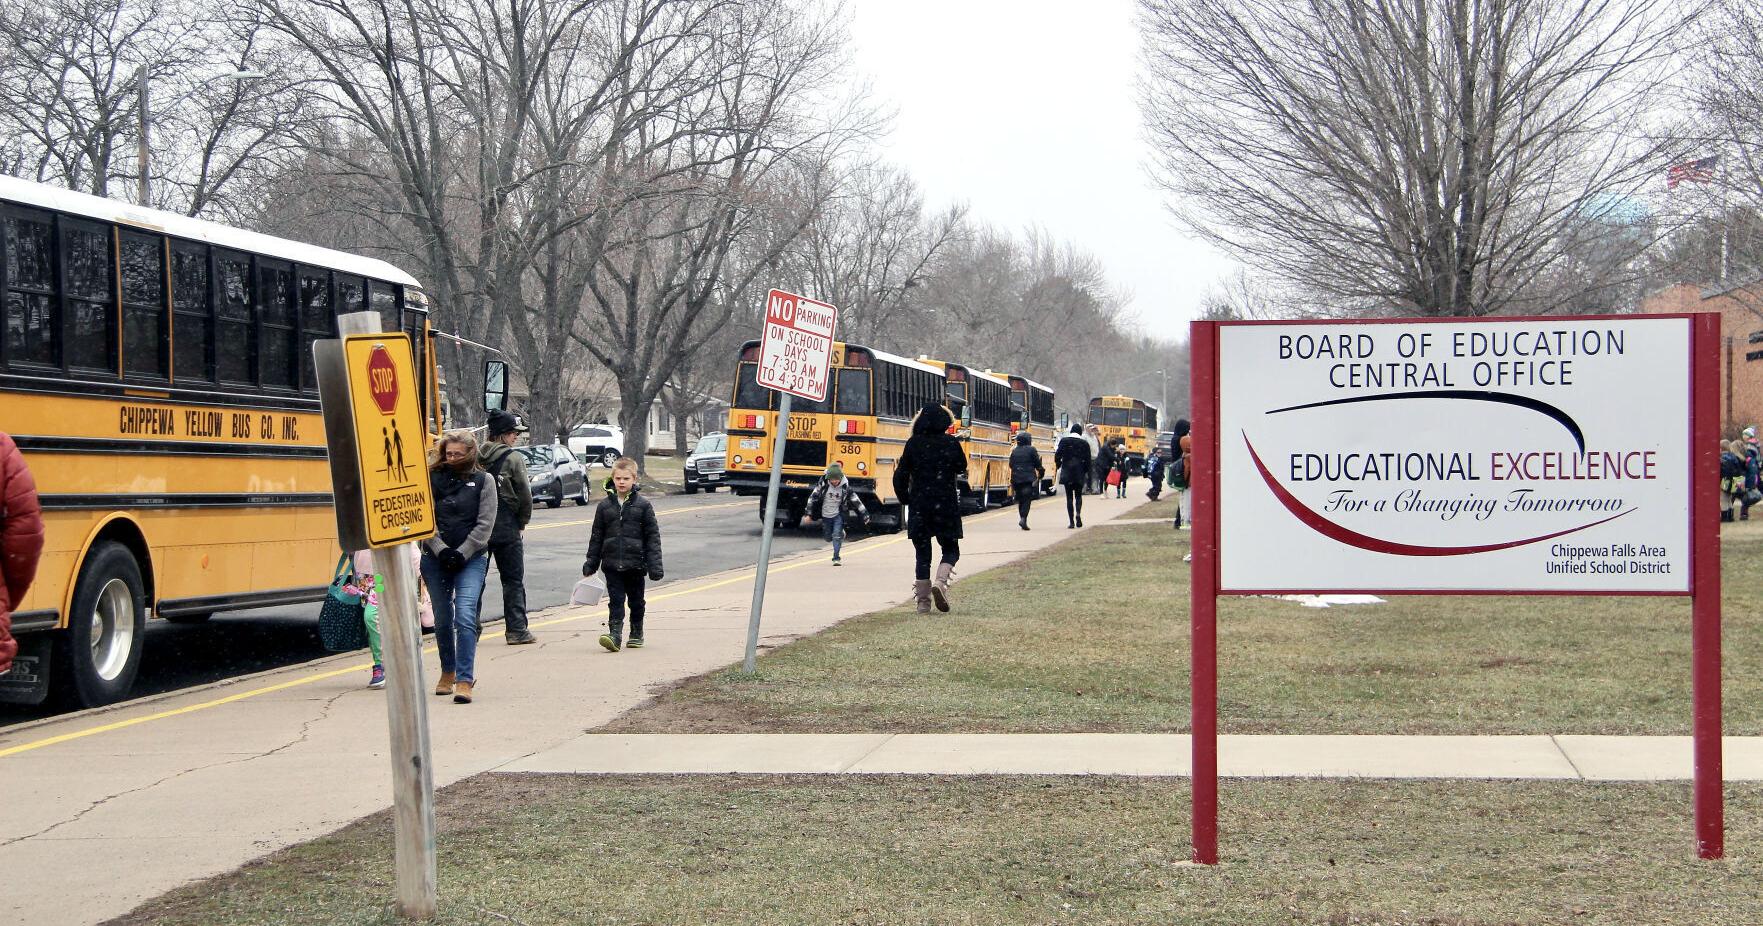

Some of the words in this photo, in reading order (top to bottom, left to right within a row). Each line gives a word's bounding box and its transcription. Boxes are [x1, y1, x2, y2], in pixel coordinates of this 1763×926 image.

[770, 296, 793, 321] NO
[797, 308, 831, 328] PARKING
[771, 326, 784, 341] ON
[788, 331, 824, 352] SCHOOL
[1279, 334, 1374, 359] BOARD
[1397, 333, 1432, 358] OF
[1453, 330, 1625, 357] EDUCATION
[784, 344, 808, 361] DAYS
[763, 366, 775, 381] TO
[779, 372, 804, 389] 4:30
[807, 379, 823, 394] PM
[773, 355, 797, 373] 7:30
[801, 364, 817, 379] AM
[1329, 363, 1455, 388] CENTRAL
[1473, 361, 1573, 386] OFFICE
[372, 368, 393, 394] STOP
[120, 405, 174, 435] CHIPPEWA
[185, 410, 223, 438] YELLOW
[232, 413, 250, 439] BUS
[261, 415, 275, 440] CO.
[282, 416, 299, 441] INC.
[788, 416, 817, 431] STOP
[840, 445, 861, 455] 380
[1290, 452, 1480, 481] EDUCATIONAL
[1491, 451, 1657, 480] EXCELLENCE
[373, 491, 426, 514] PEDESTRIAN
[1324, 490, 1370, 513] For
[1373, 500, 1387, 512] a
[1393, 489, 1497, 521] Changing
[1504, 488, 1625, 512] Tomorrow
[381, 508, 423, 530] CROSSING
[1551, 544, 1609, 559] Chippewa
[1611, 544, 1637, 557] Falls
[1639, 544, 1667, 557] Area
[1546, 560, 1587, 574] Unified
[1589, 560, 1628, 574] School
[1630, 560, 1671, 574] District
